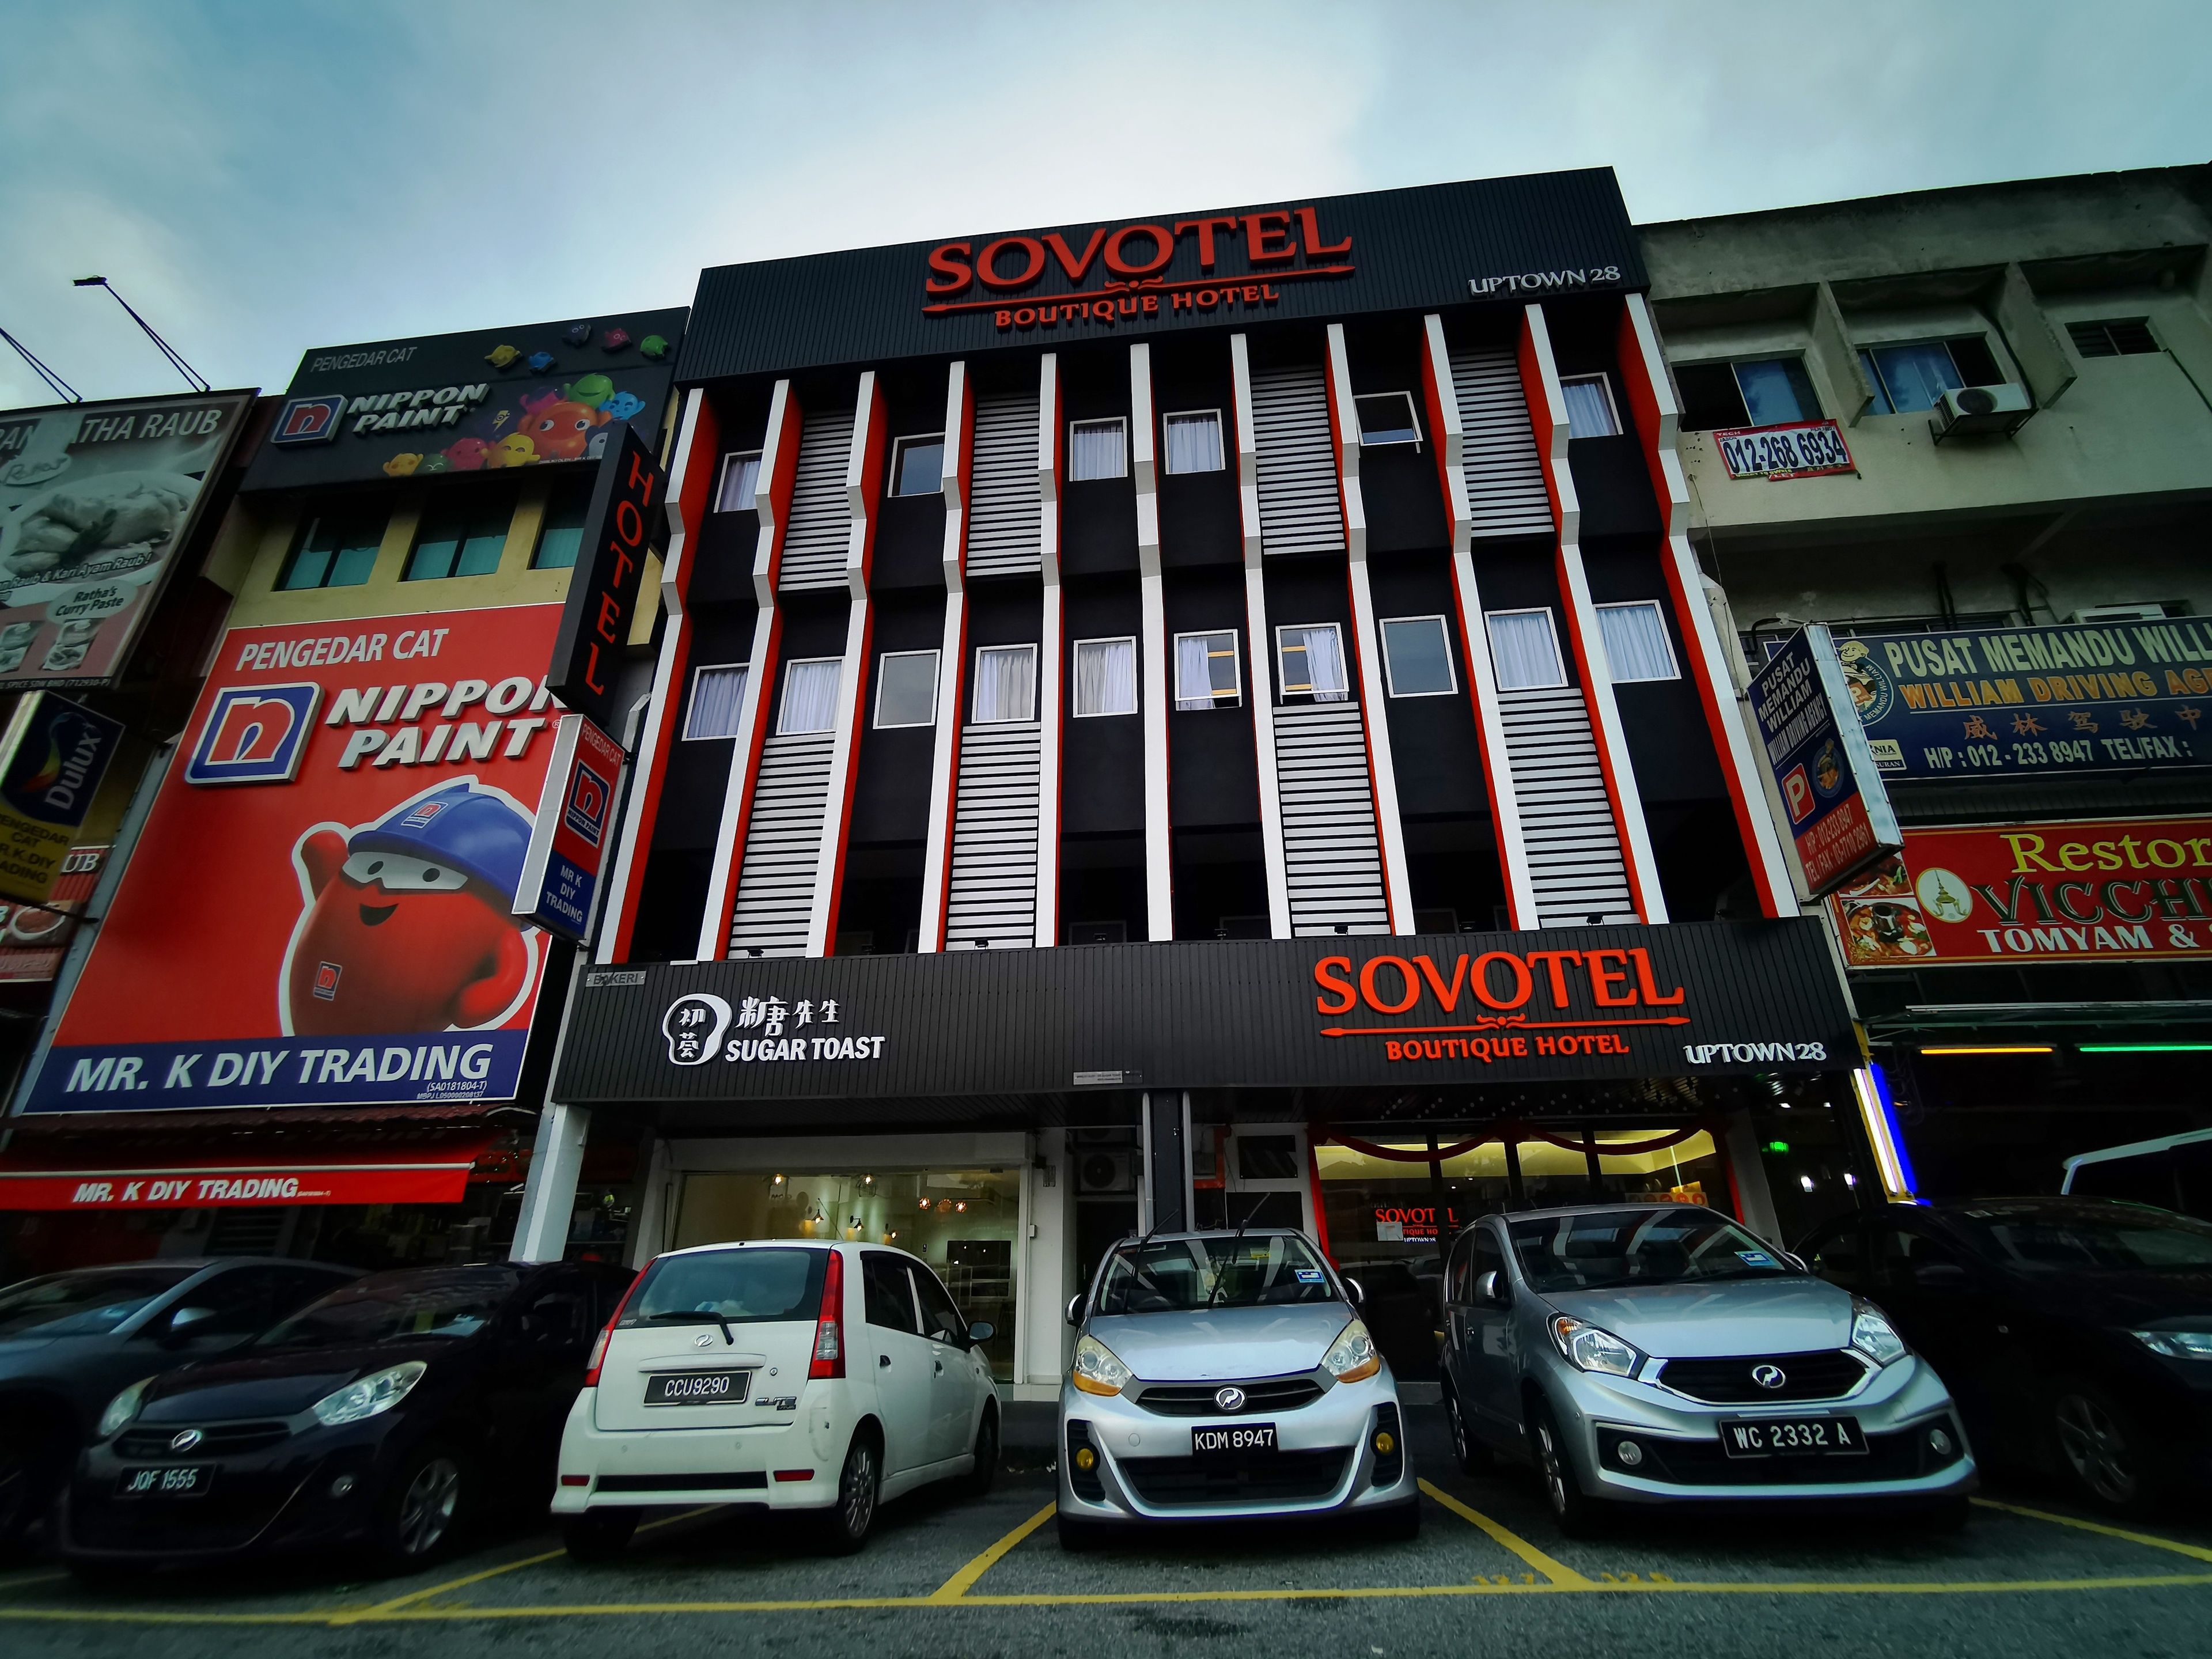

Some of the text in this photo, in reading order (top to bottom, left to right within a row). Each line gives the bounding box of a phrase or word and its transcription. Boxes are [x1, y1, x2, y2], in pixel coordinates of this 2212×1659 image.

[925, 206, 1352, 296] SOVOTEL
[1468, 266, 1621, 296] UPTOWN 28
[995, 284, 1279, 329] BOUTIQUE HOTEL
[309, 346, 418, 373] PENGEDAR CAT
[347, 382, 490, 415] NIPPON
[139, 409, 222, 439] RAUB
[352, 404, 466, 434] PAINT
[1723, 430, 1847, 474] 012-268 6934
[10, 571, 41, 589] Raub
[77, 560, 112, 578] Ayam
[112, 552, 145, 570] Raub
[584, 450, 654, 696] HOTEL
[55, 597, 124, 616] Curry Paste
[73, 586, 118, 603] Ratha's
[236, 628, 449, 671] PENGEDAR CAT
[1883, 637, 1979, 679] PUSAT
[1978, 627, 2137, 673] MEMANDU
[1758, 657, 1811, 722] MEMANDU
[1762, 652, 1795, 698] PUSAT
[1897, 677, 2025, 710] WILLIAM
[2026, 670, 2158, 702] DRIVING
[1766, 679, 1812, 733] WILLIAM
[1864, 664, 1888, 721] MEMANDU WILLIAM
[1805, 692, 1828, 734] AGENCY
[337, 717, 548, 770] PAINT
[582, 724, 622, 767] PENGEDAR CAT
[1971, 744, 2003, 767] 012
[2016, 741, 2048, 765] 233
[2048, 740, 2094, 763] 8947
[2101, 735, 2179, 761] TEL/FAX
[44, 736, 102, 810] Dulux
[12, 832, 40, 847] CAT
[1999, 834, 2212, 873] Restor
[28, 853, 56, 869] DIY
[560, 865, 582, 888] MR K
[546, 891, 583, 923] TRADING
[560, 882, 576, 900] DIY
[1969, 875, 2212, 926] VICCH
[1976, 923, 2201, 953] TOMYAM &
[1314, 946, 1685, 1017] SOVOTEL
[734, 995, 841, 1037] 糖先生
[724, 1036, 886, 1063] SUGAR TOAST
[1385, 1034, 1630, 1063] BOUTIQUE HOTEL
[1683, 1040, 1828, 1066] UPTOWN 28
[66, 1043, 494, 1093] MR. K DIY TRADING
[73, 1177, 299, 1203] MR. K DIY TRADING
[1375, 1207, 1459, 1223] SOVOTL
[664, 1376, 730, 1397] CCU9290
[1195, 1429, 1274, 1450] KDM 8947
[1733, 1422, 1852, 1449] WC 2332 A
[161, 1468, 199, 1490] 1555
